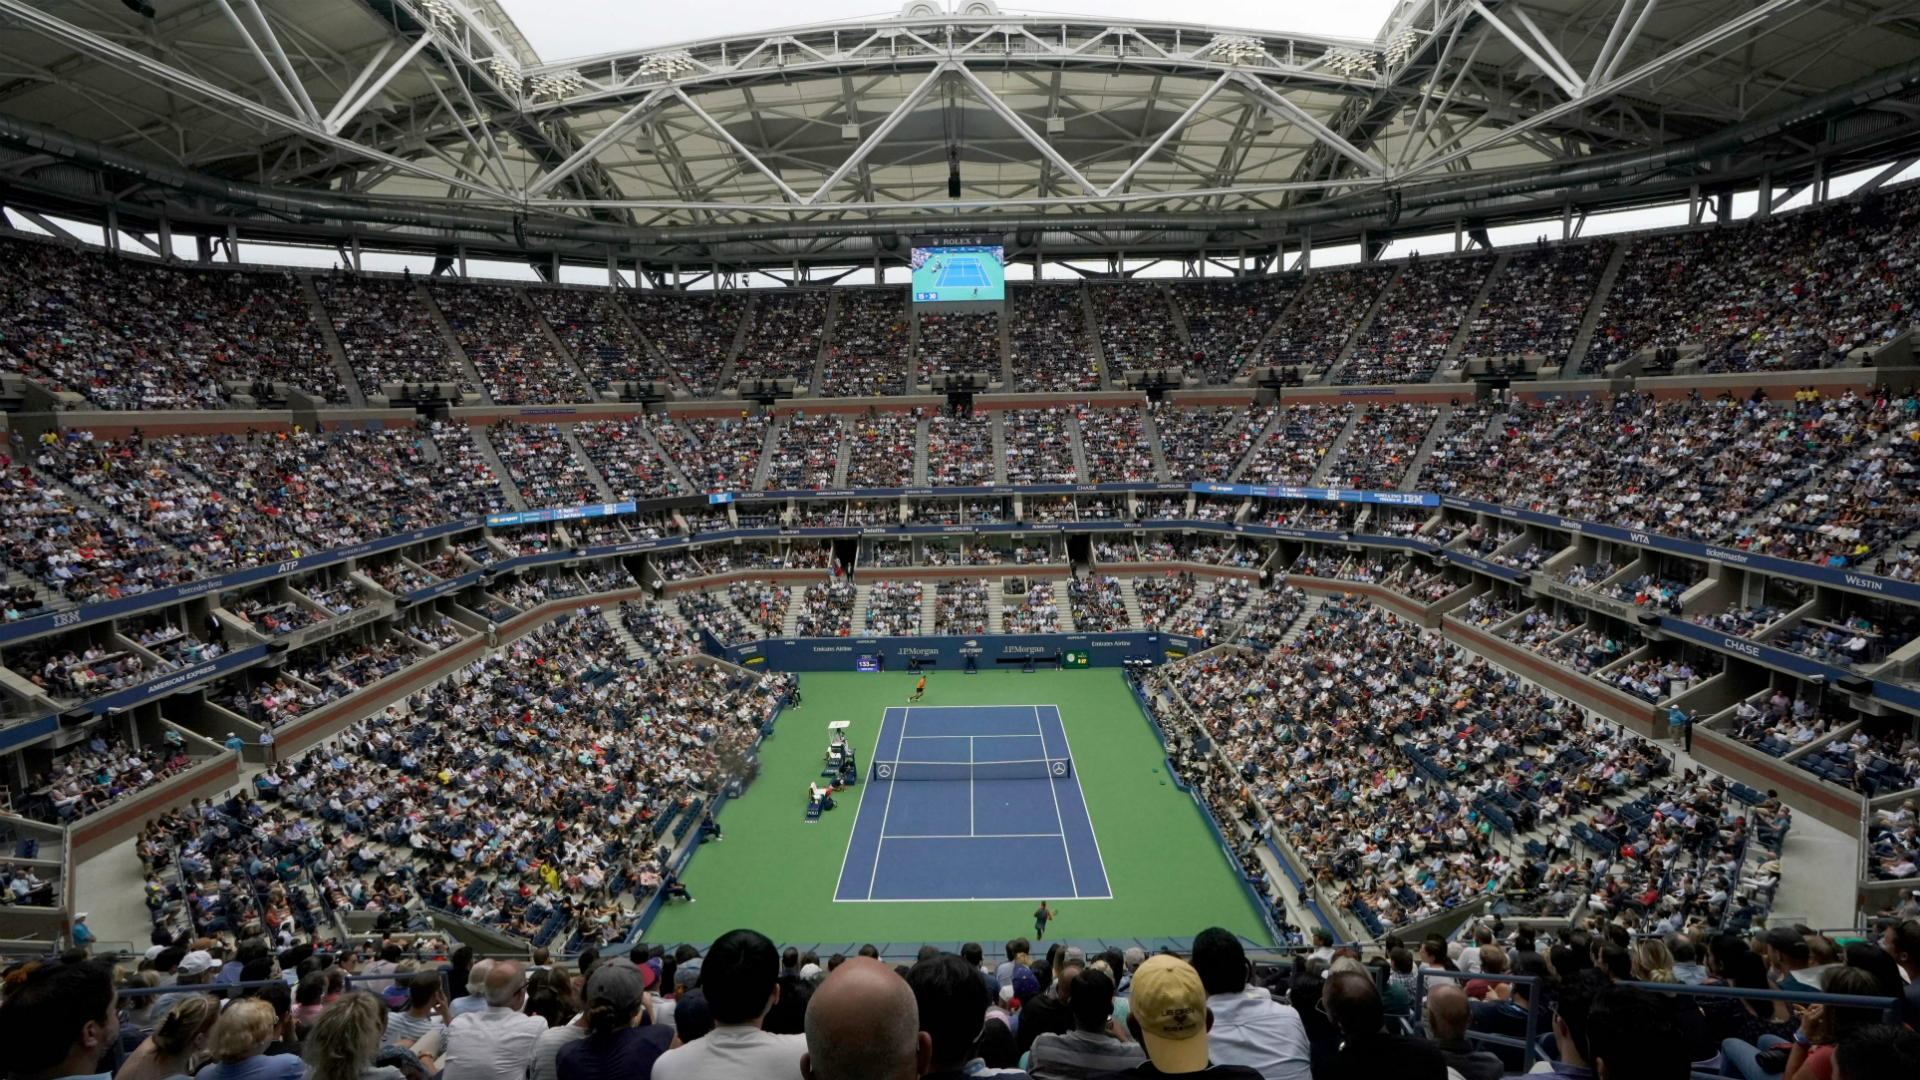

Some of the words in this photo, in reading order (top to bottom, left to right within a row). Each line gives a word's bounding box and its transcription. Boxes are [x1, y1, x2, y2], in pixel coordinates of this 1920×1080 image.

[1403, 494, 1423, 504] IBM
[464, 519, 478, 527] CHASE
[1560, 519, 1582, 530] Deloitte
[1630, 532, 1650, 545] WTA
[1706, 548, 1749, 563] ticketmaster
[278, 560, 299, 573] ATP
[178, 579, 222, 596] Mercedes-Benz
[1845, 574, 1883, 590] WESTIN
[53, 610, 80, 627] IBM
[897, 648, 939, 656] J.P.Morgan
[1003, 646, 1044, 654] J.P.Morgan
[1725, 638, 1760, 657] CHASE
[148, 675, 185, 694] AMERICAN
[186, 664, 216, 682] EXPRESS
[1175, 1007, 1195, 1015] OPEN
